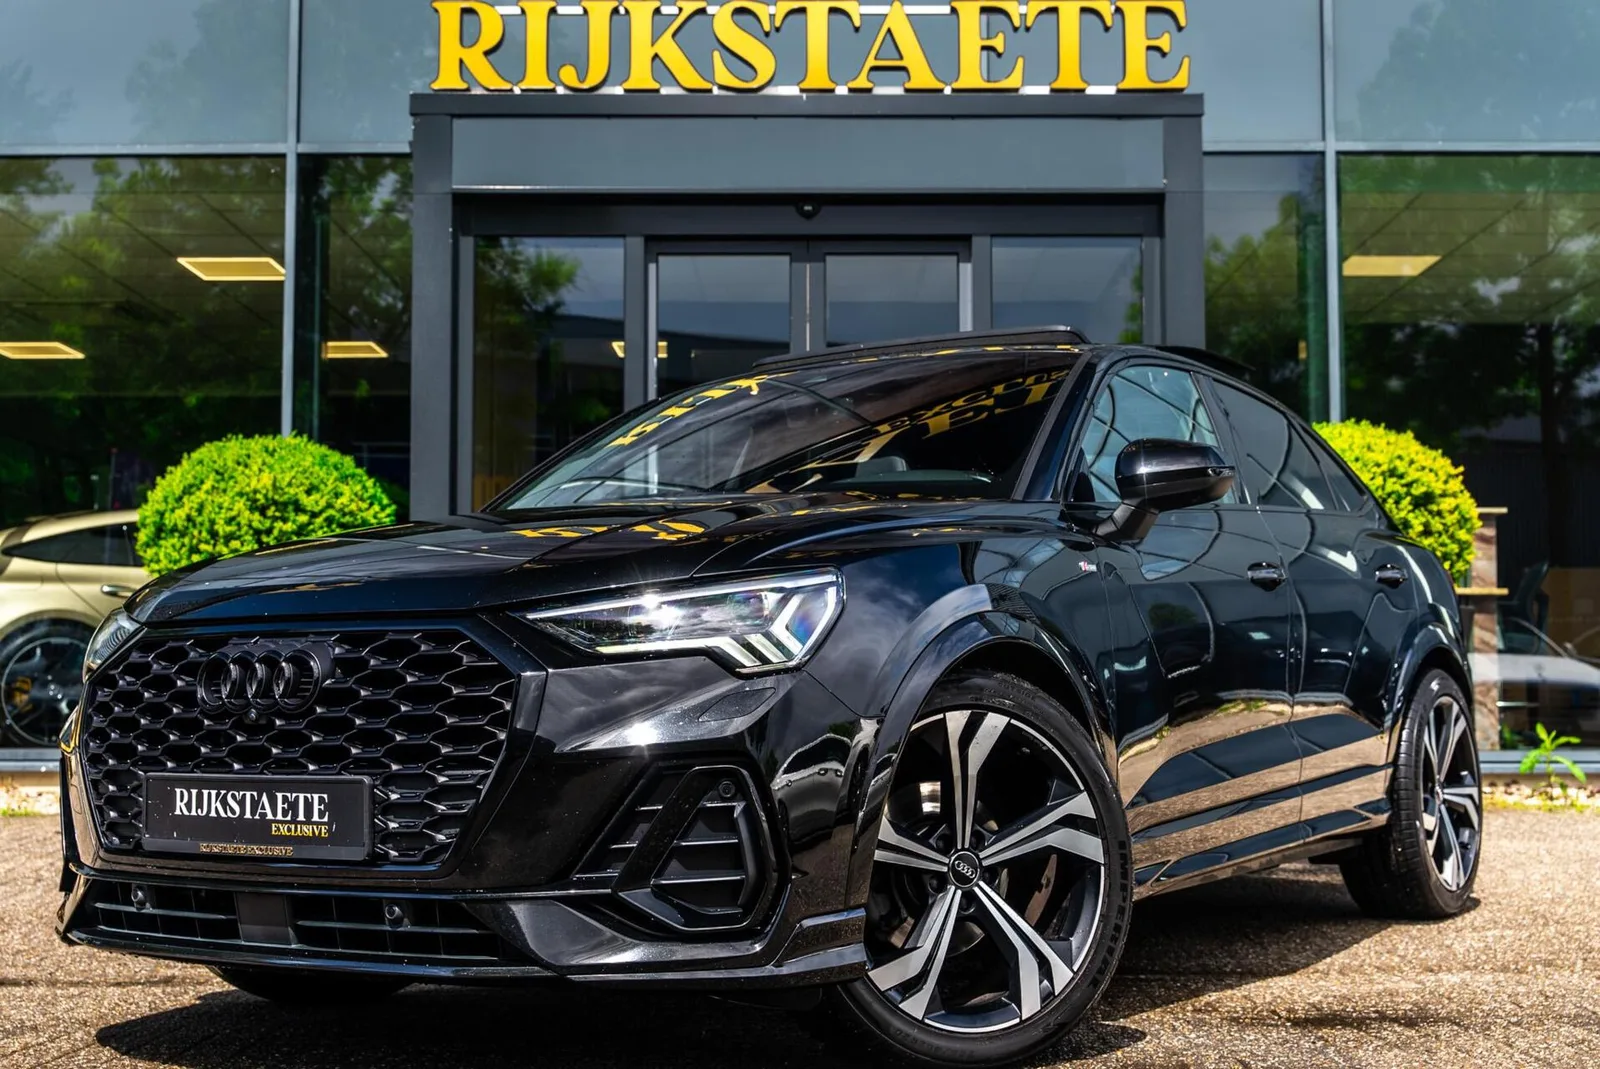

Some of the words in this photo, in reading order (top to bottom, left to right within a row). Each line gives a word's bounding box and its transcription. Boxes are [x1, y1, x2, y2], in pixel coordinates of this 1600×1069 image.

[430, 0, 1191, 92] RIJKSTAETE
[174, 788, 329, 822] RIJKSTAETE
[271, 823, 329, 837] EXCLUSIVE
[247, 845, 294, 856] EXCLUSIVE
